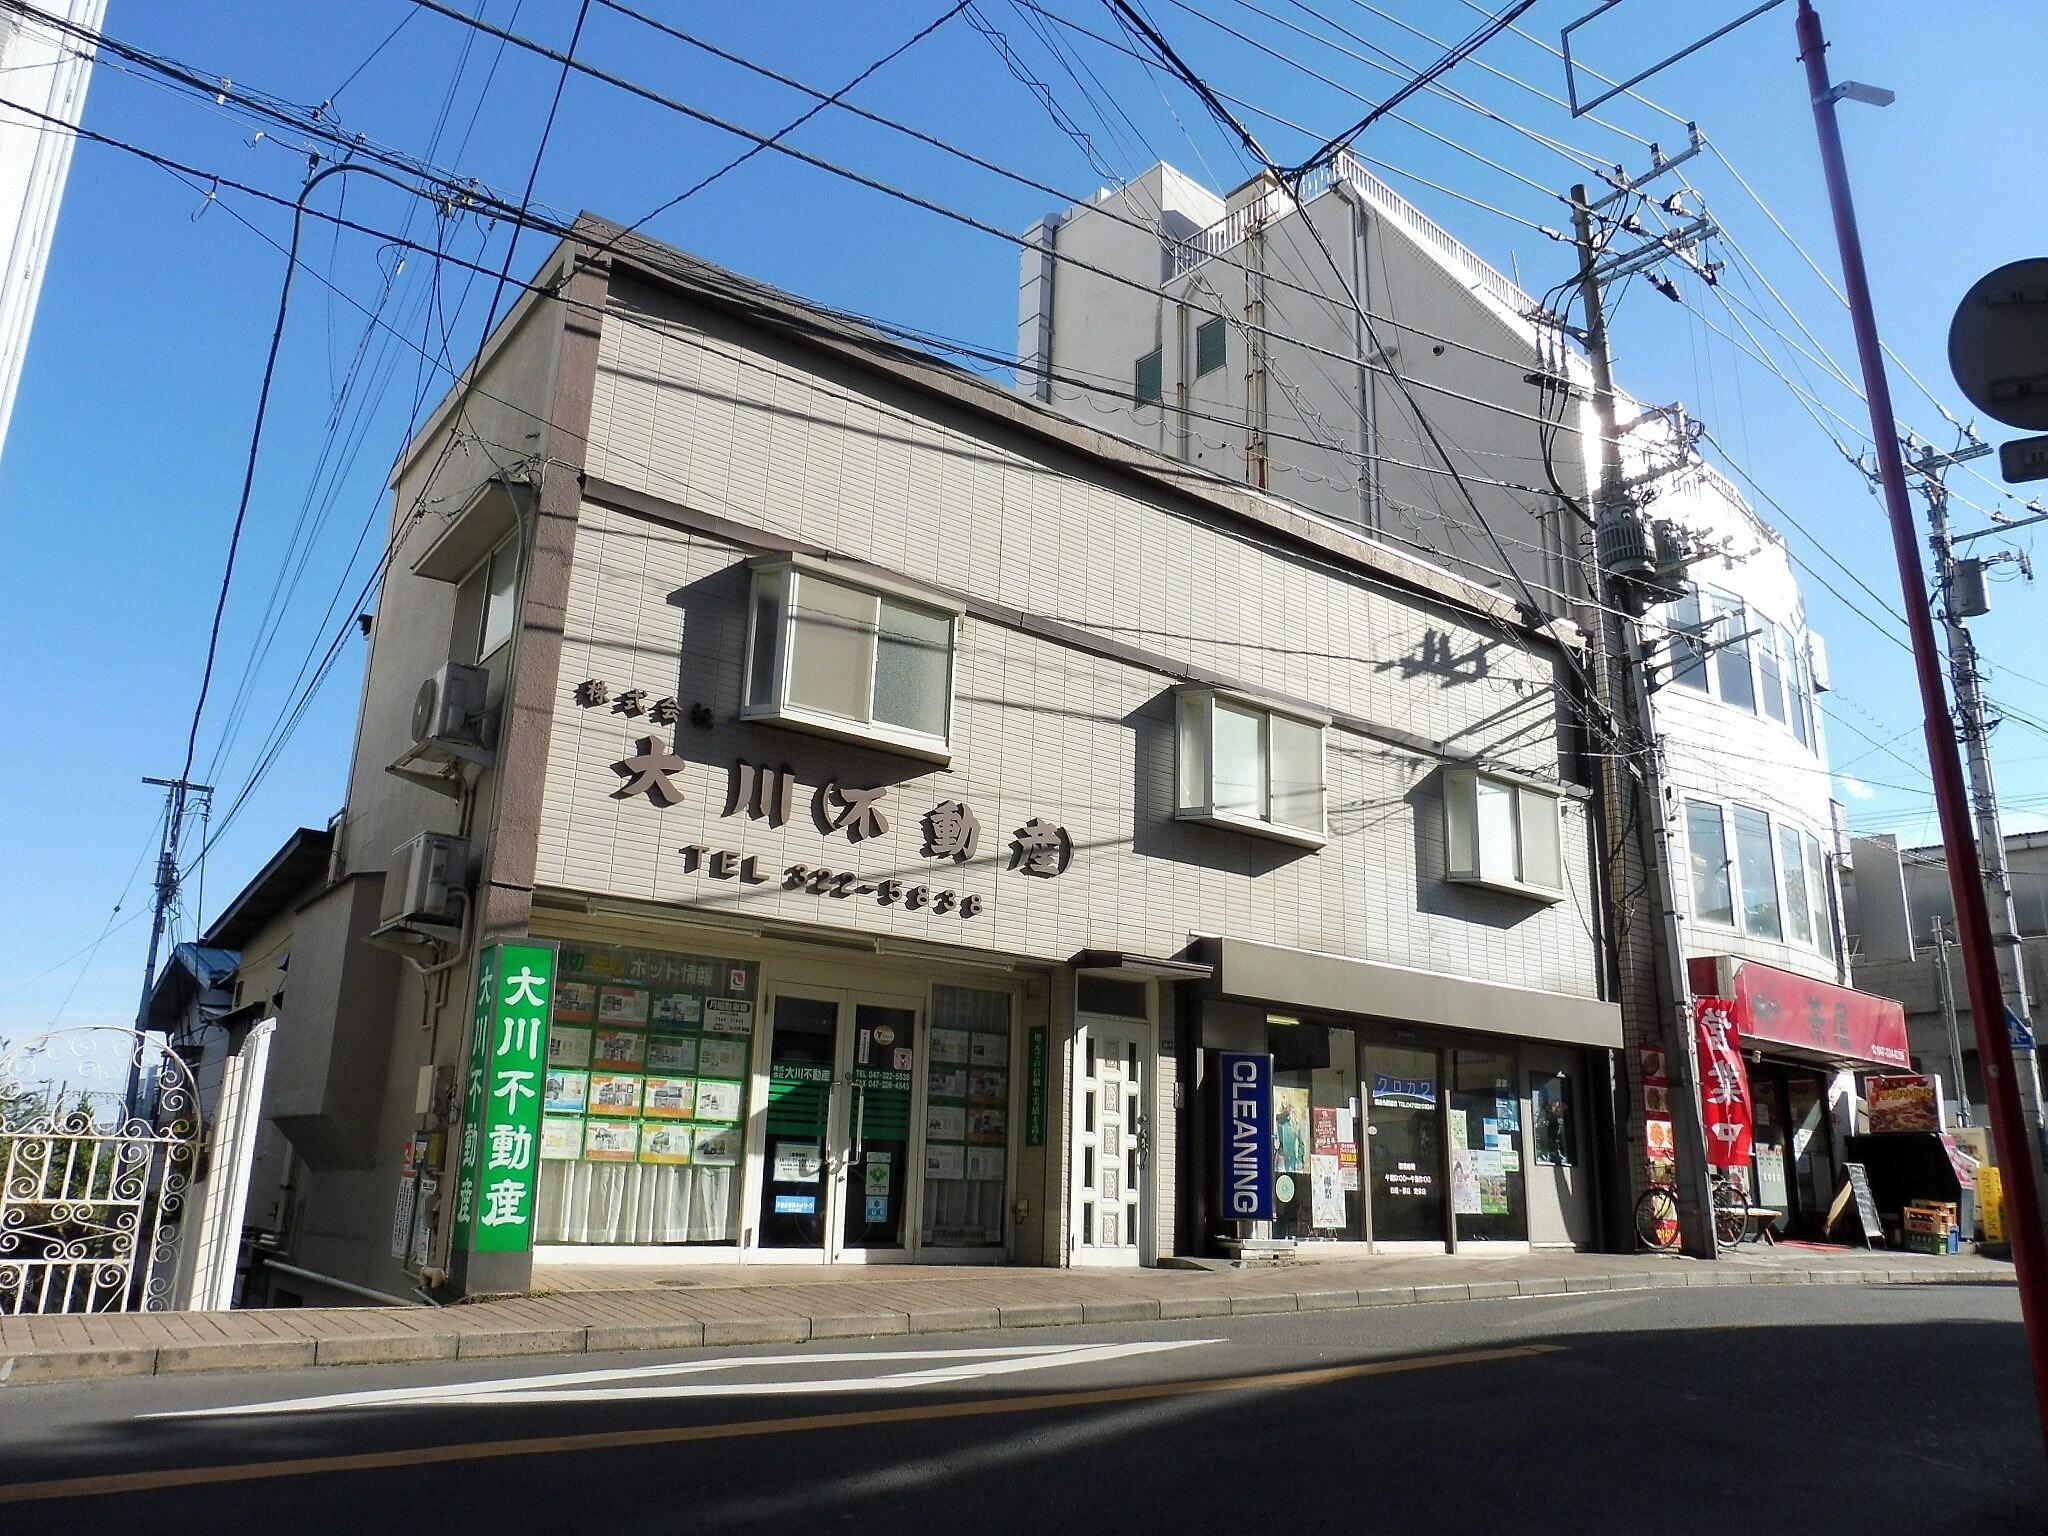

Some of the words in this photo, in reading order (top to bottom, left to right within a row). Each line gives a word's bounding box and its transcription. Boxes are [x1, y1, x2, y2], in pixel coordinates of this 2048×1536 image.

[680, 845, 769, 884] TEL
[782, 863, 983, 919] 322-5838
[457, 966, 493, 1223] 大川不動産
[481, 966, 546, 1226] 大川不動産
[784, 1067, 831, 1081] 大川不動産
[856, 1069, 867, 1078] TEL
[1232, 1061, 1259, 1213] CLEANING
[1701, 1007, 1744, 1158] 営業中
